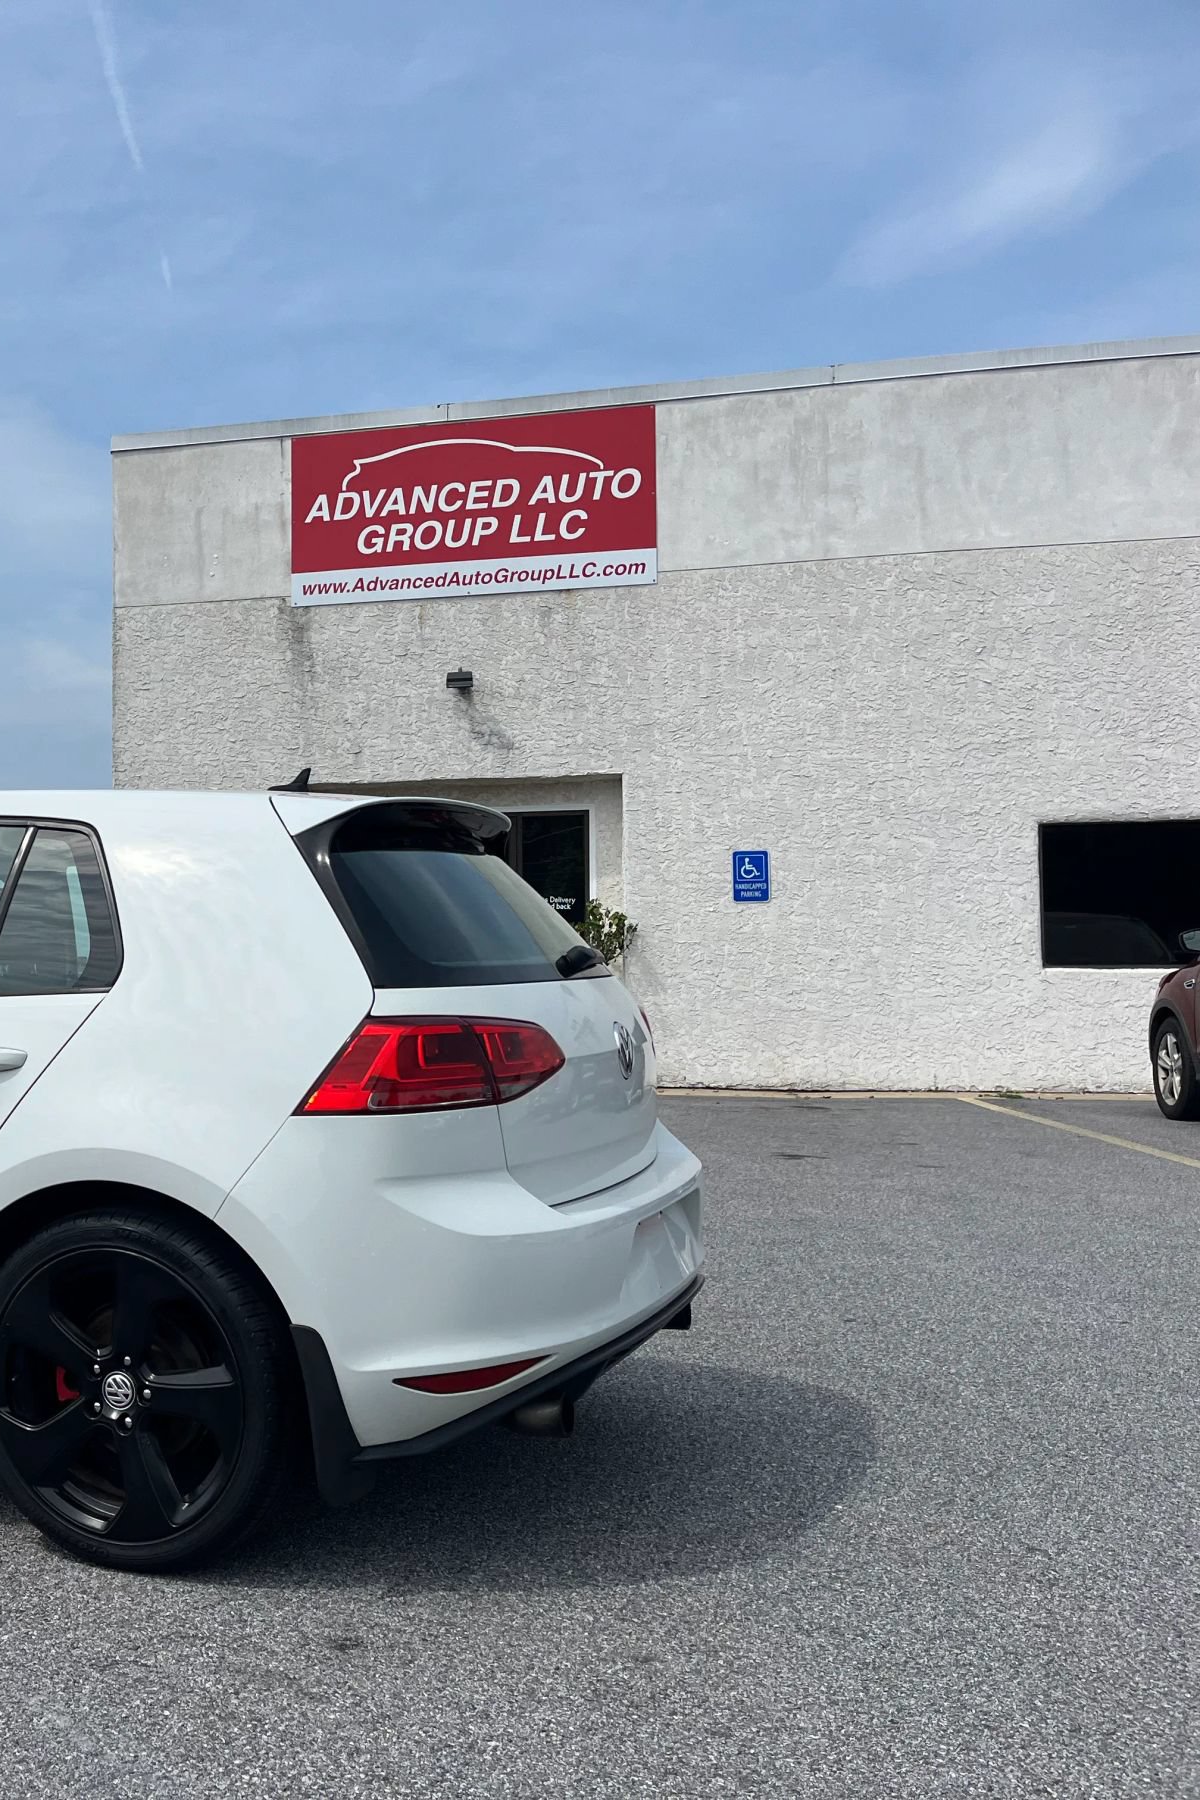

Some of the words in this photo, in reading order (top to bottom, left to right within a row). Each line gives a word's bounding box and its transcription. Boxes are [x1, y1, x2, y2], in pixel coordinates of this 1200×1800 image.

[304, 478, 521, 524] ADVANCED
[527, 467, 642, 506] AUTO
[356, 516, 499, 555] GROUP
[508, 509, 588, 544] LLC
[301, 560, 647, 597] www.AdvancedAutoGroupLLC.com
[549, 895, 576, 905] Delivery
[740, 890, 762, 898] PARKING
[555, 902, 572, 910] back
